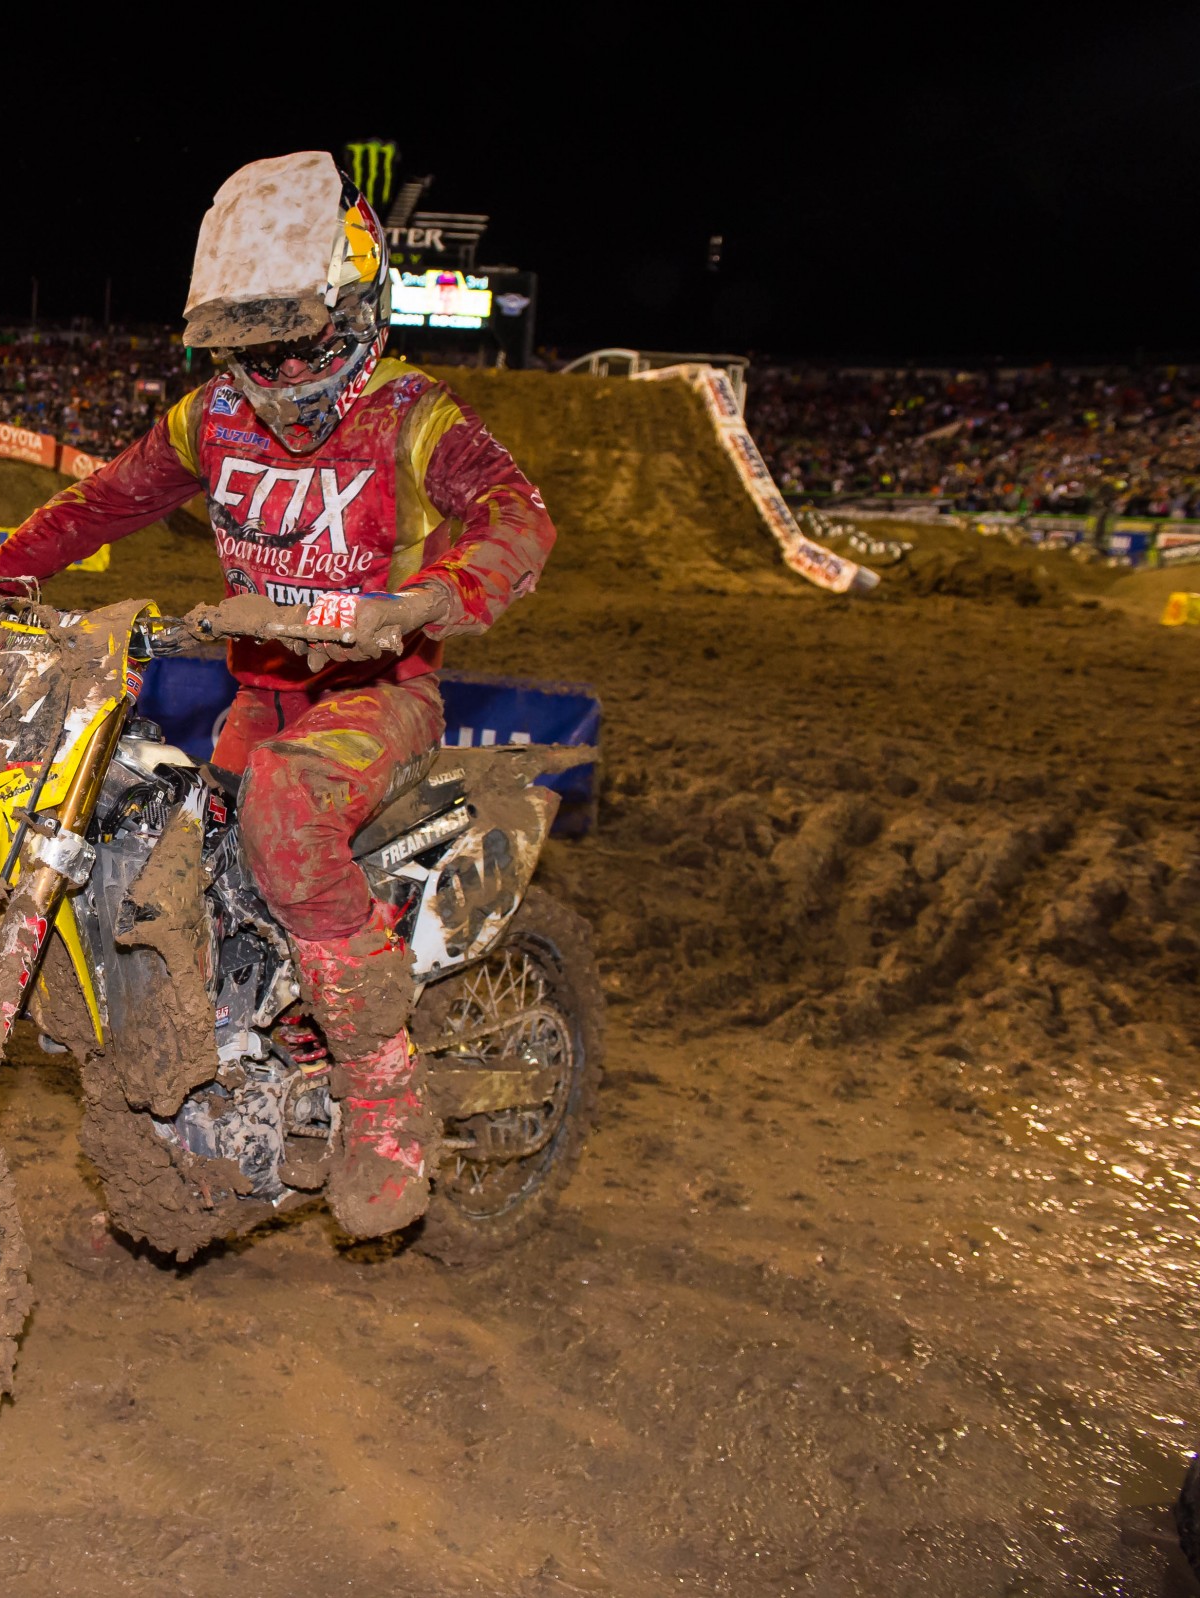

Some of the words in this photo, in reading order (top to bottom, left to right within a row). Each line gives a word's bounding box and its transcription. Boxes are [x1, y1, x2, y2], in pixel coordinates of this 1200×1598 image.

[215, 426, 270, 450] SUZUKI
[213, 456, 377, 554] FOX
[215, 528, 293, 576] Soaring
[293, 543, 374, 582] Eagle
[381, 824, 434, 869] FREAKY
